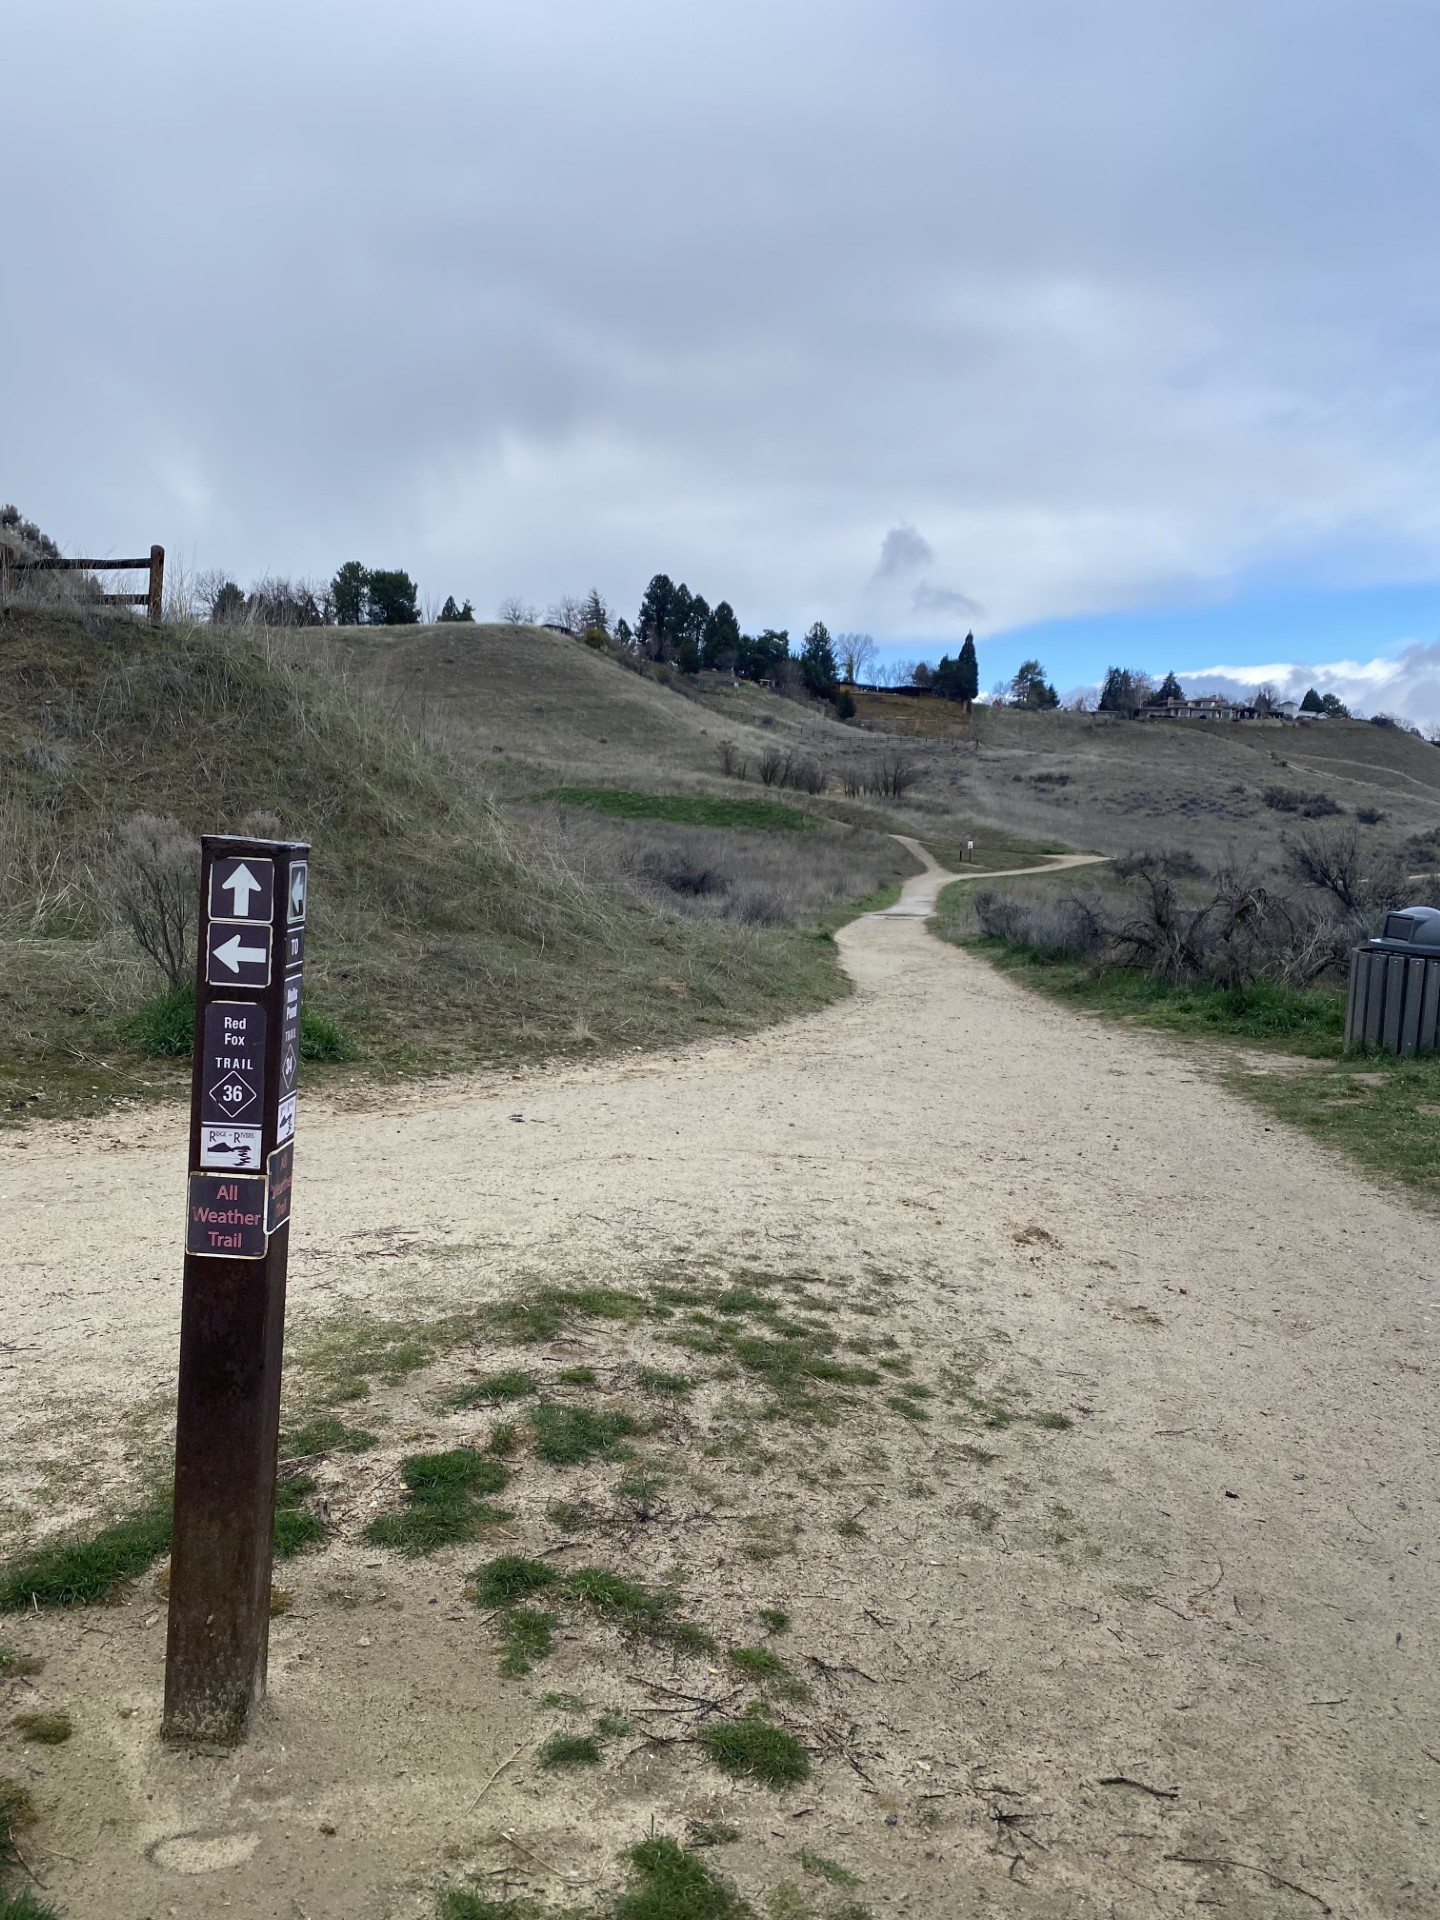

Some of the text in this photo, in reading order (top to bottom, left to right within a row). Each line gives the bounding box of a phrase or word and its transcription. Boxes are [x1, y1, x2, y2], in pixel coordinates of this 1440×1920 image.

[224, 1016, 247, 1030] Red
[224, 1032, 246, 1046] Fox
[215, 1057, 254, 1070] TRAIL
[222, 1085, 243, 1102] 36
[216, 1184, 238, 1200] All
[192, 1206, 262, 1226] Weather
[208, 1231, 242, 1248] Trail
